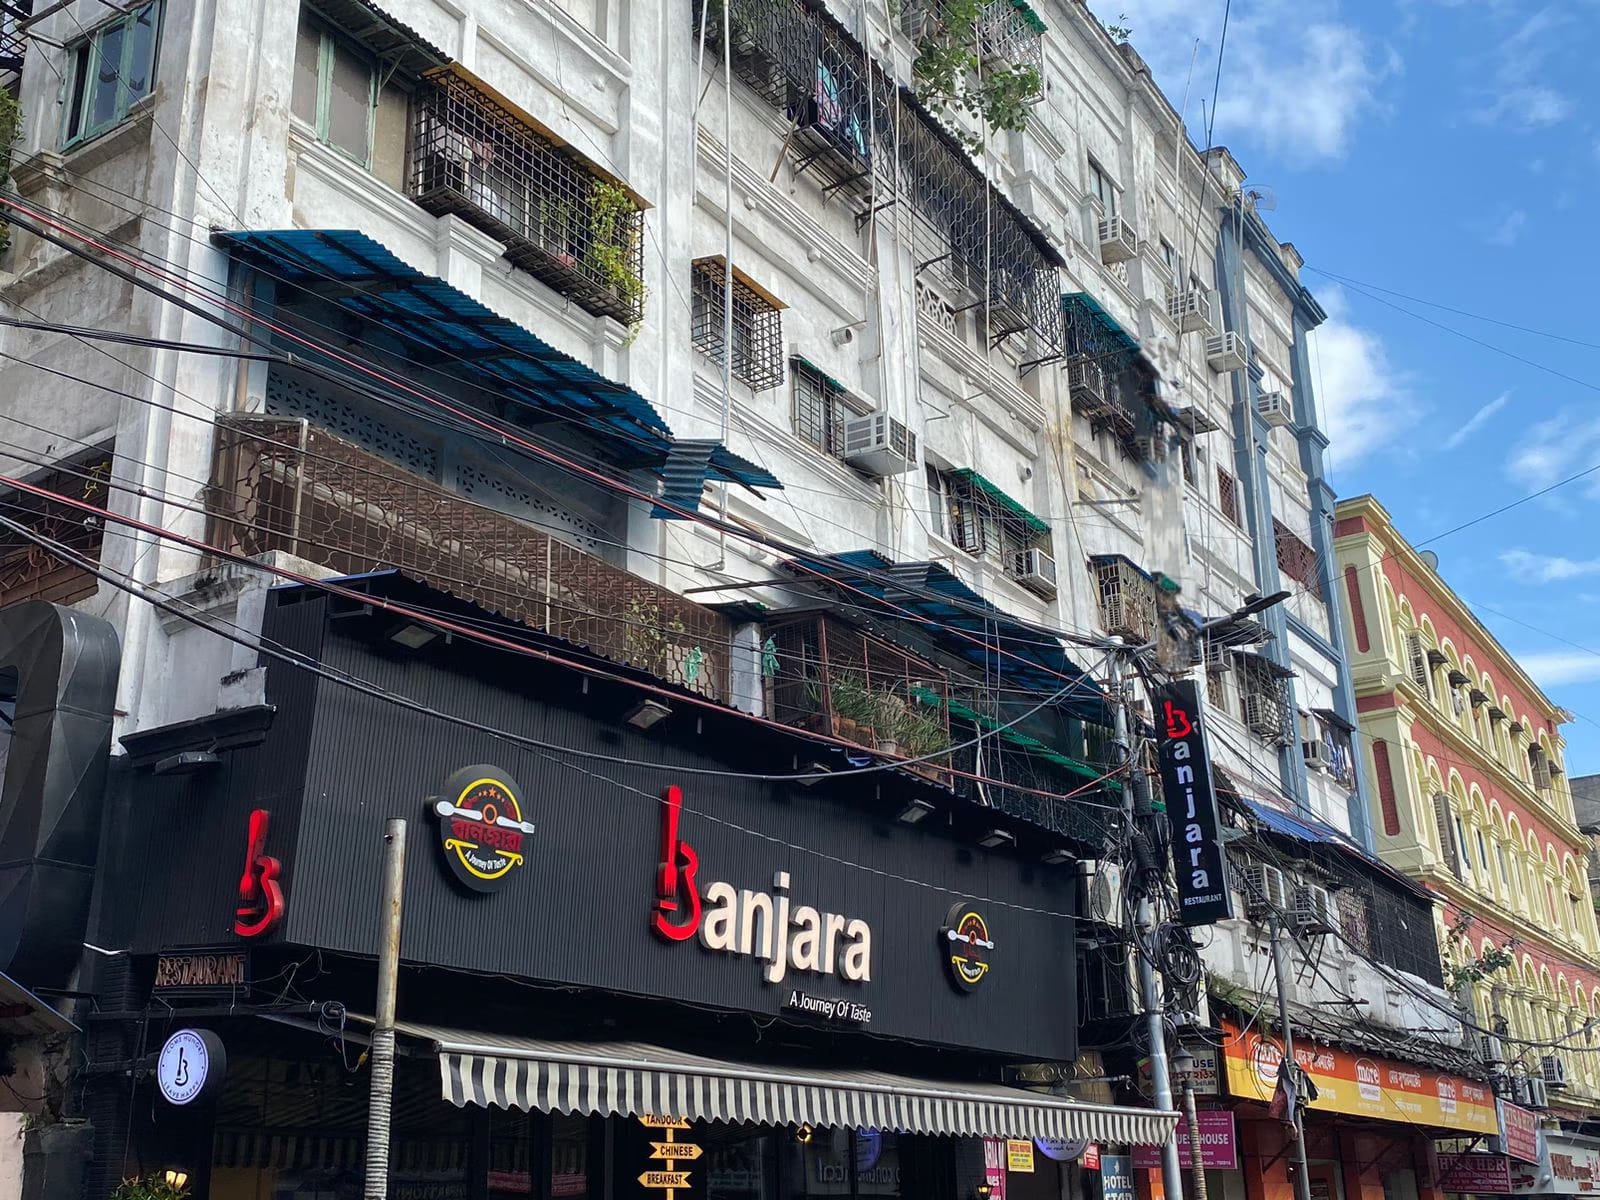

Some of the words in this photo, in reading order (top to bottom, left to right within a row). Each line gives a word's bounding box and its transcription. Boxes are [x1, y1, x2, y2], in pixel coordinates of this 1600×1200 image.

[651, 784, 871, 983] Banjara
[1183, 893, 1222, 906] RESTAURANT
[155, 954, 246, 986] RESTAURANT
[789, 990, 798, 1006] A
[799, 993, 836, 1019] Journey
[836, 999, 849, 1017] Of
[850, 1002, 872, 1023] Taste
[166, 1037, 183, 1054] COME
[183, 1035, 204, 1055] HUNGRY
[163, 1081, 180, 1099] LEAVE
[180, 1081, 200, 1099] HAPPY
[1199, 1133, 1229, 1145] HOUSE
[660, 1145, 693, 1157] CHINESE
[1476, 1158, 1507, 1172] HER
[646, 1173, 683, 1185] BREAKFAST
[1103, 1174, 1133, 1189] HOTEL
